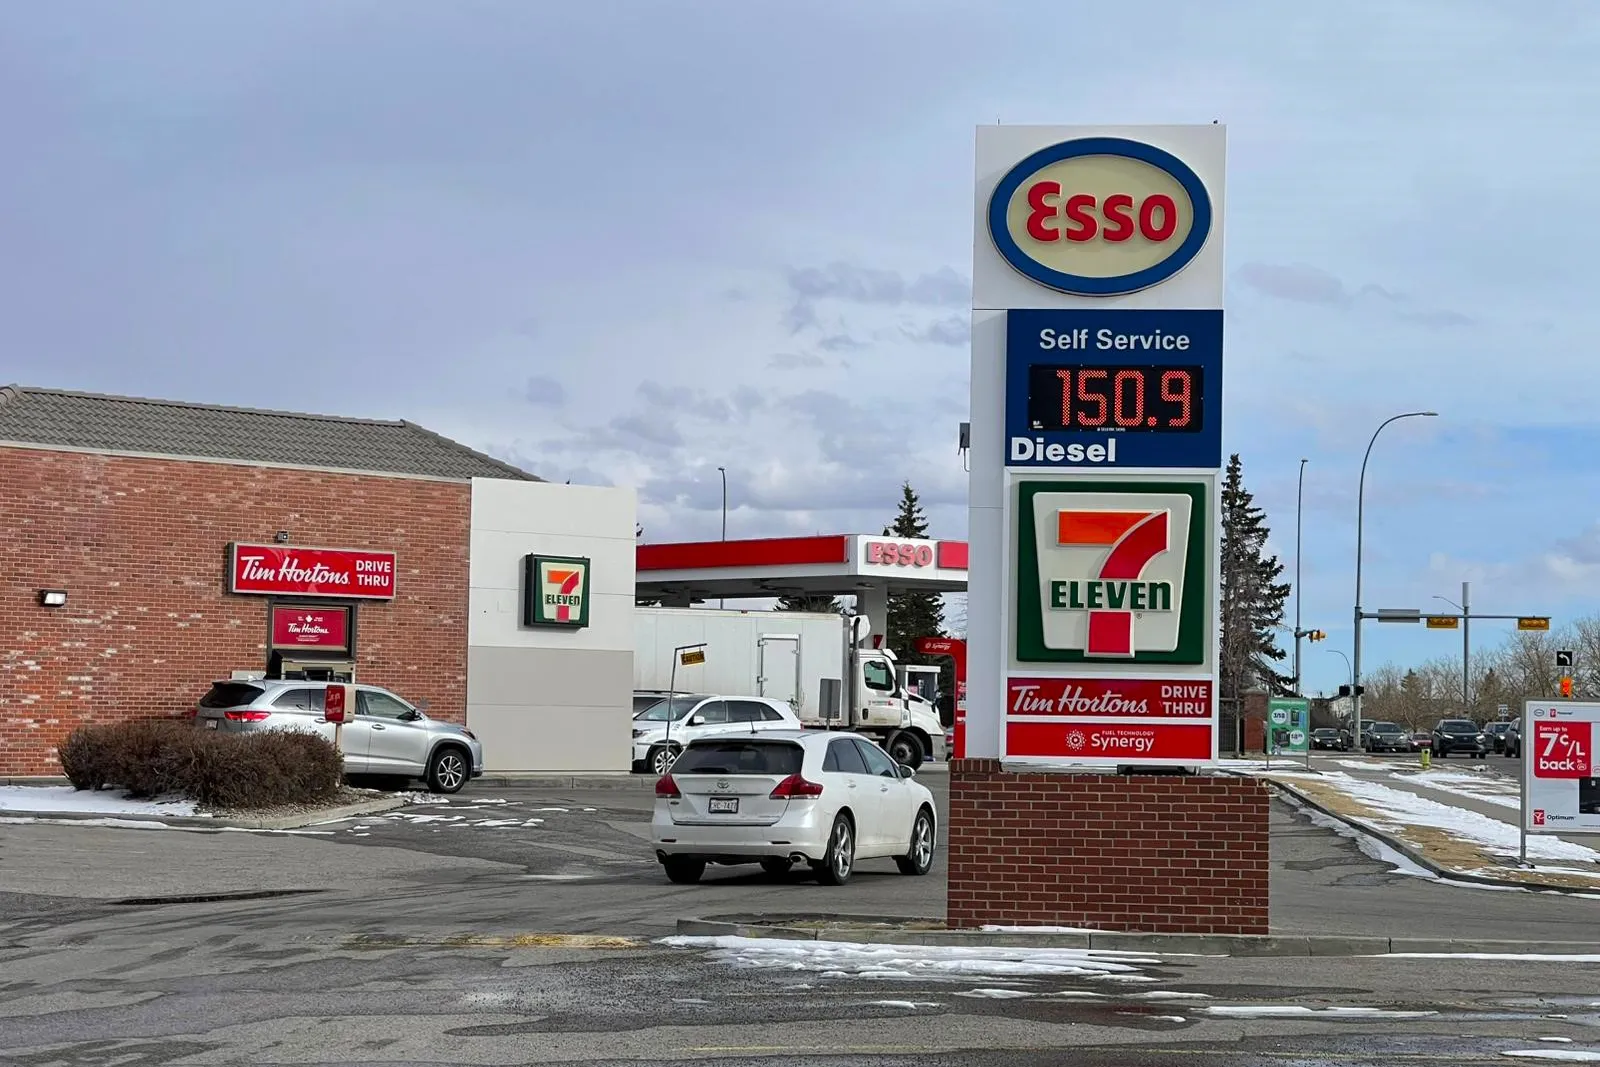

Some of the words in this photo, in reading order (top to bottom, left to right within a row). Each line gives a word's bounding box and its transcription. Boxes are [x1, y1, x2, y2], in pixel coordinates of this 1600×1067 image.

[1027, 180, 1178, 243] Esso
[1039, 328, 1089, 350] Self
[1096, 328, 1191, 351] Service
[1056, 370, 1192, 427] 150.9
[1011, 436, 1117, 462] Diesel
[867, 541, 933, 567] ESSO
[240, 556, 275, 581] Tim
[277, 556, 351, 585] Hortons
[356, 560, 392, 573] DRIVE
[357, 574, 390, 587] THRU
[1056, 509, 1170, 656] 7
[288, 623, 301, 634] Tim
[301, 623, 329, 634] Hortons
[1011, 685, 1053, 713] Tim
[1058, 684, 1150, 714] Hortons
[1161, 685, 1208, 699] DRIVE
[1163, 701, 1206, 715] THRU
[1091, 733, 1155, 752] Synergy
[1539, 758, 1575, 771] back
[1546, 814, 1575, 822] Optimum
